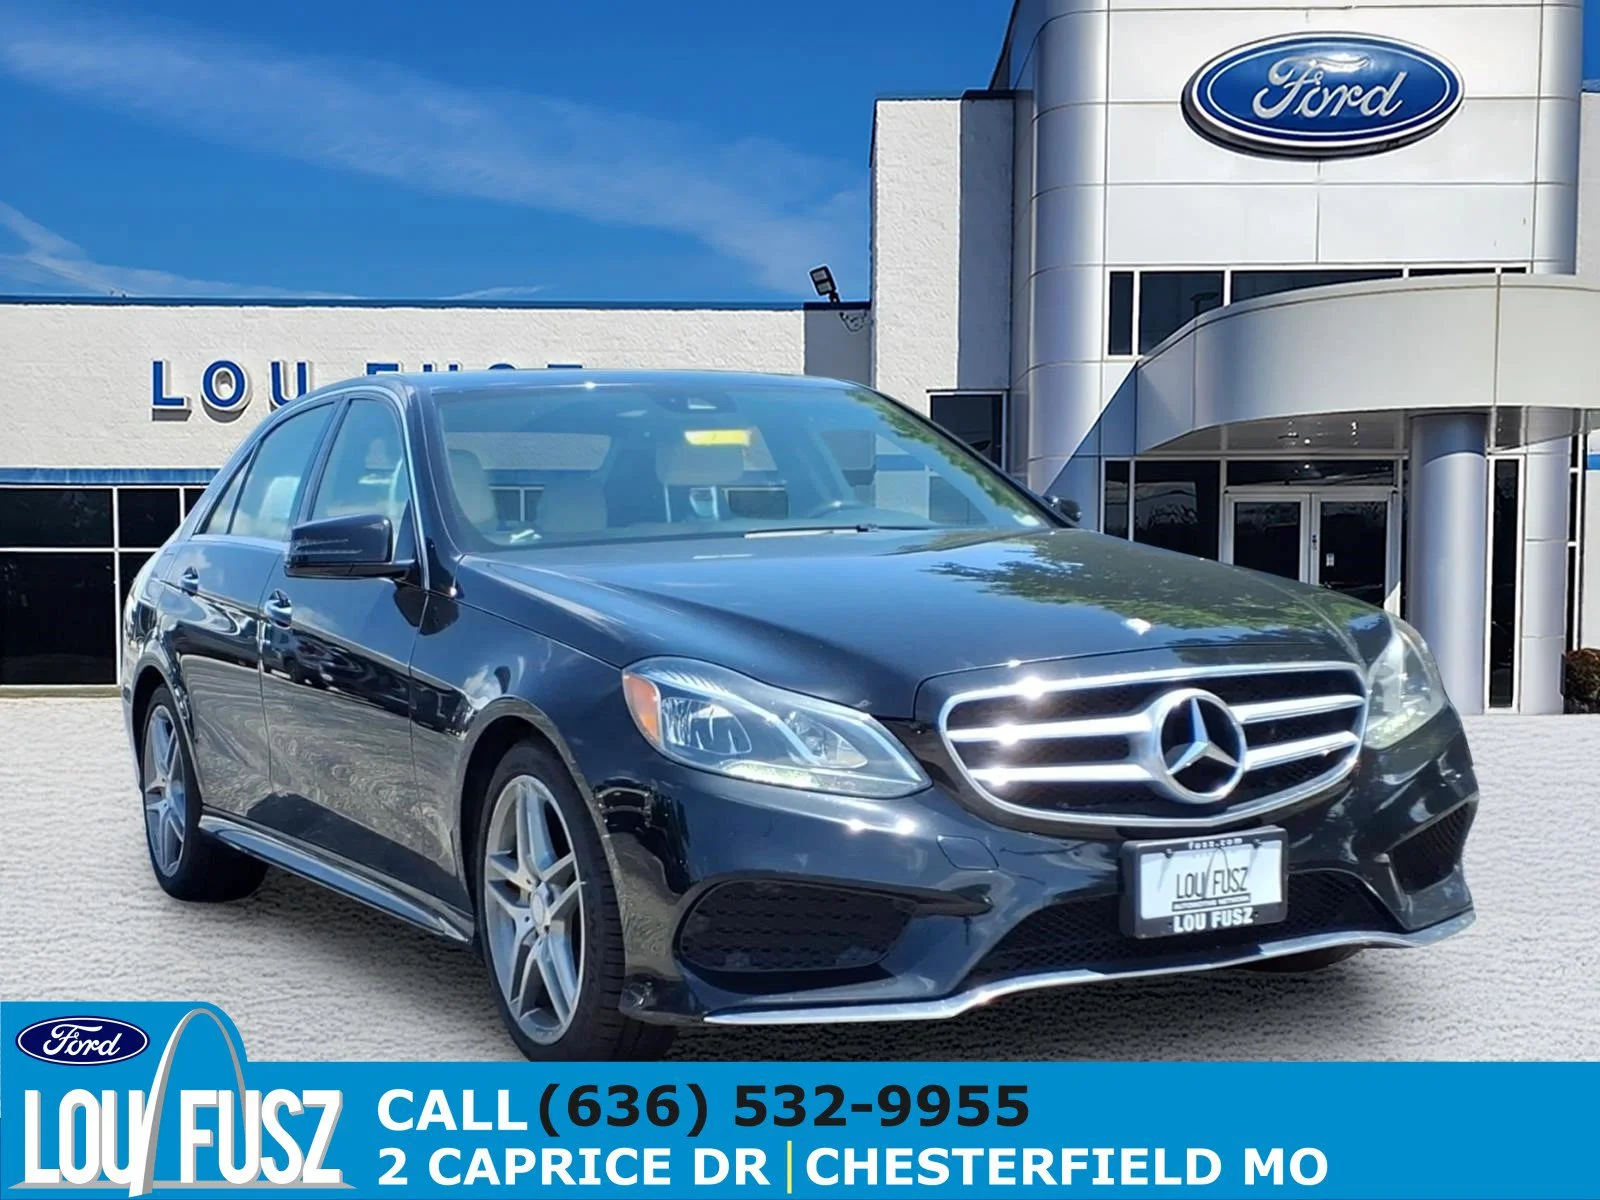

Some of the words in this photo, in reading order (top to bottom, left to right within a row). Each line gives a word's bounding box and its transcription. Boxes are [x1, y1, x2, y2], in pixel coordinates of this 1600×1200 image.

[1252, 56, 1407, 118] Ford
[152, 360, 309, 407] LOU
[1176, 872, 1205, 899] LOU
[1213, 867, 1249, 895] FUSZ
[1173, 913, 1206, 933] LOU
[1211, 907, 1254, 928] FUSZ
